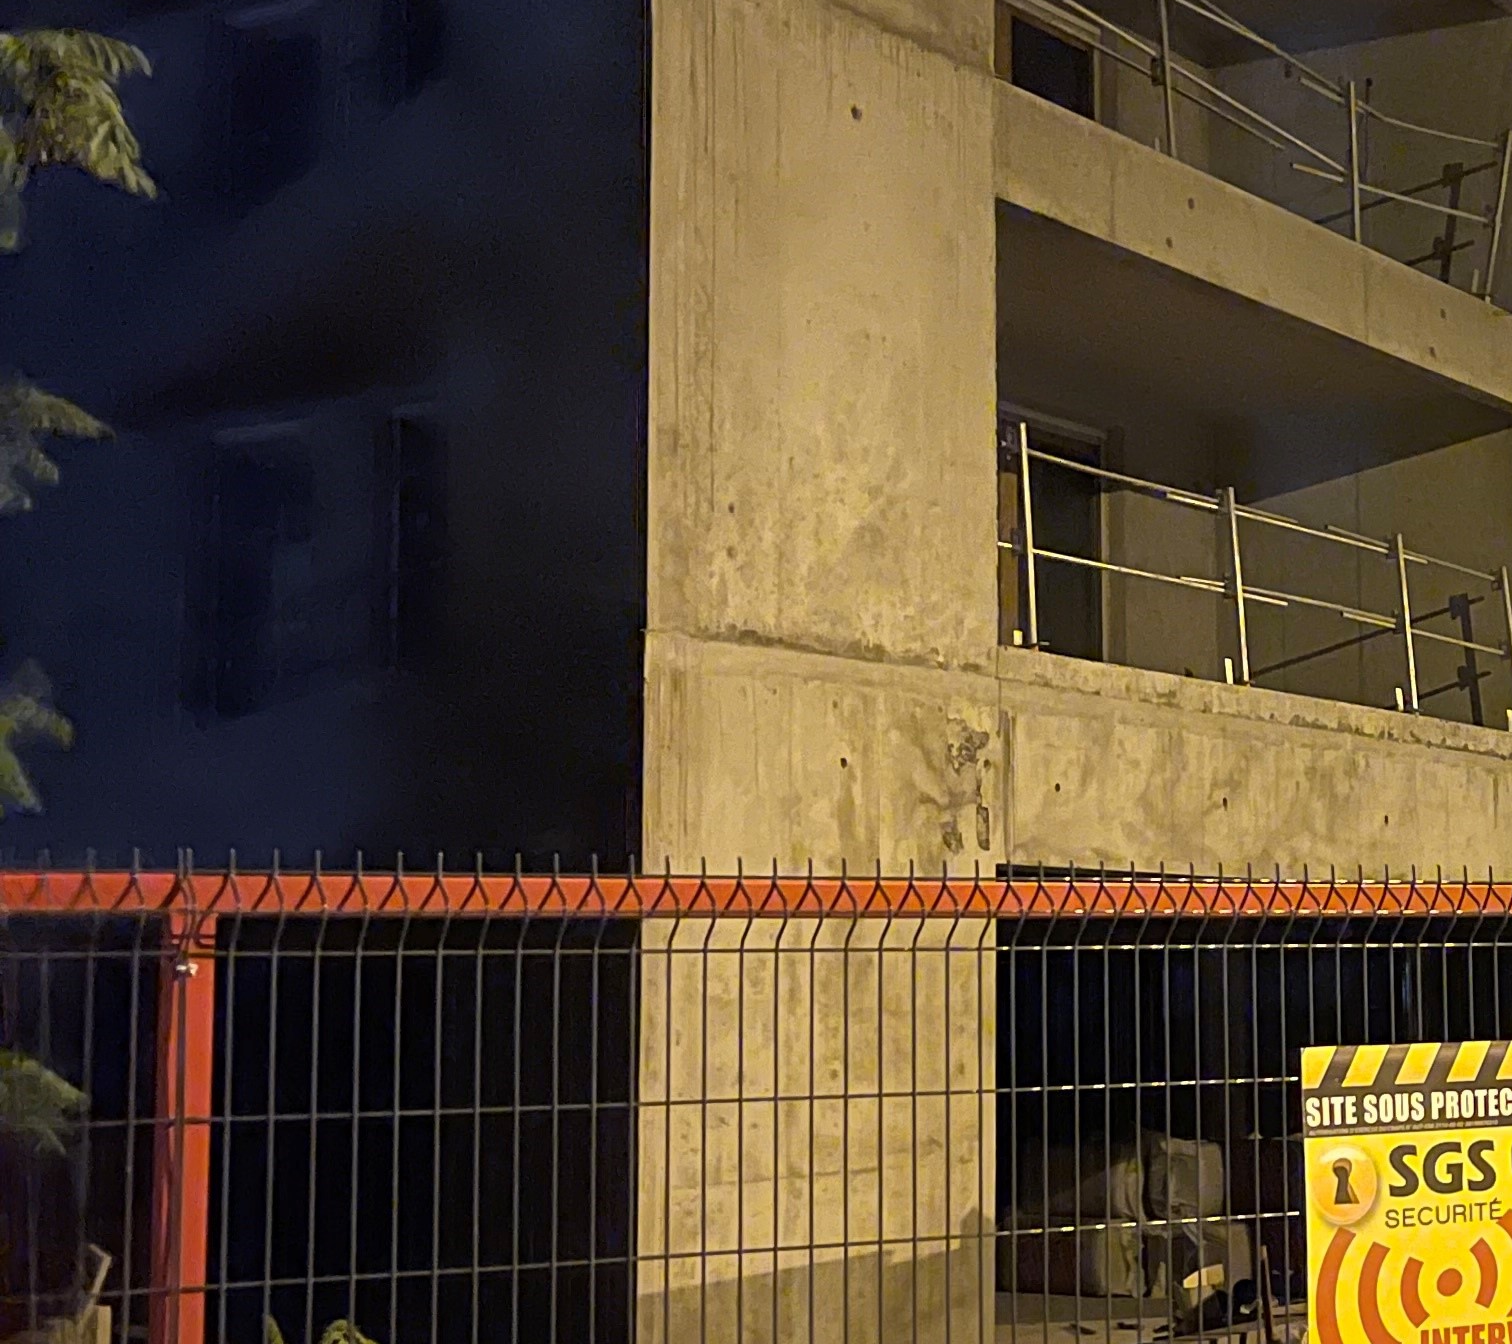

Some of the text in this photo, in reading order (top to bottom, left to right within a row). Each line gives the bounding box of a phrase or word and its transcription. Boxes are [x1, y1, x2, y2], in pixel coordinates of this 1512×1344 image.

[1306, 1094, 1358, 1127] SITE
[1363, 1090, 1426, 1124] SOUS
[1388, 1139, 1497, 1198] SGS
[1384, 1199, 1503, 1229] SECURITÉ
